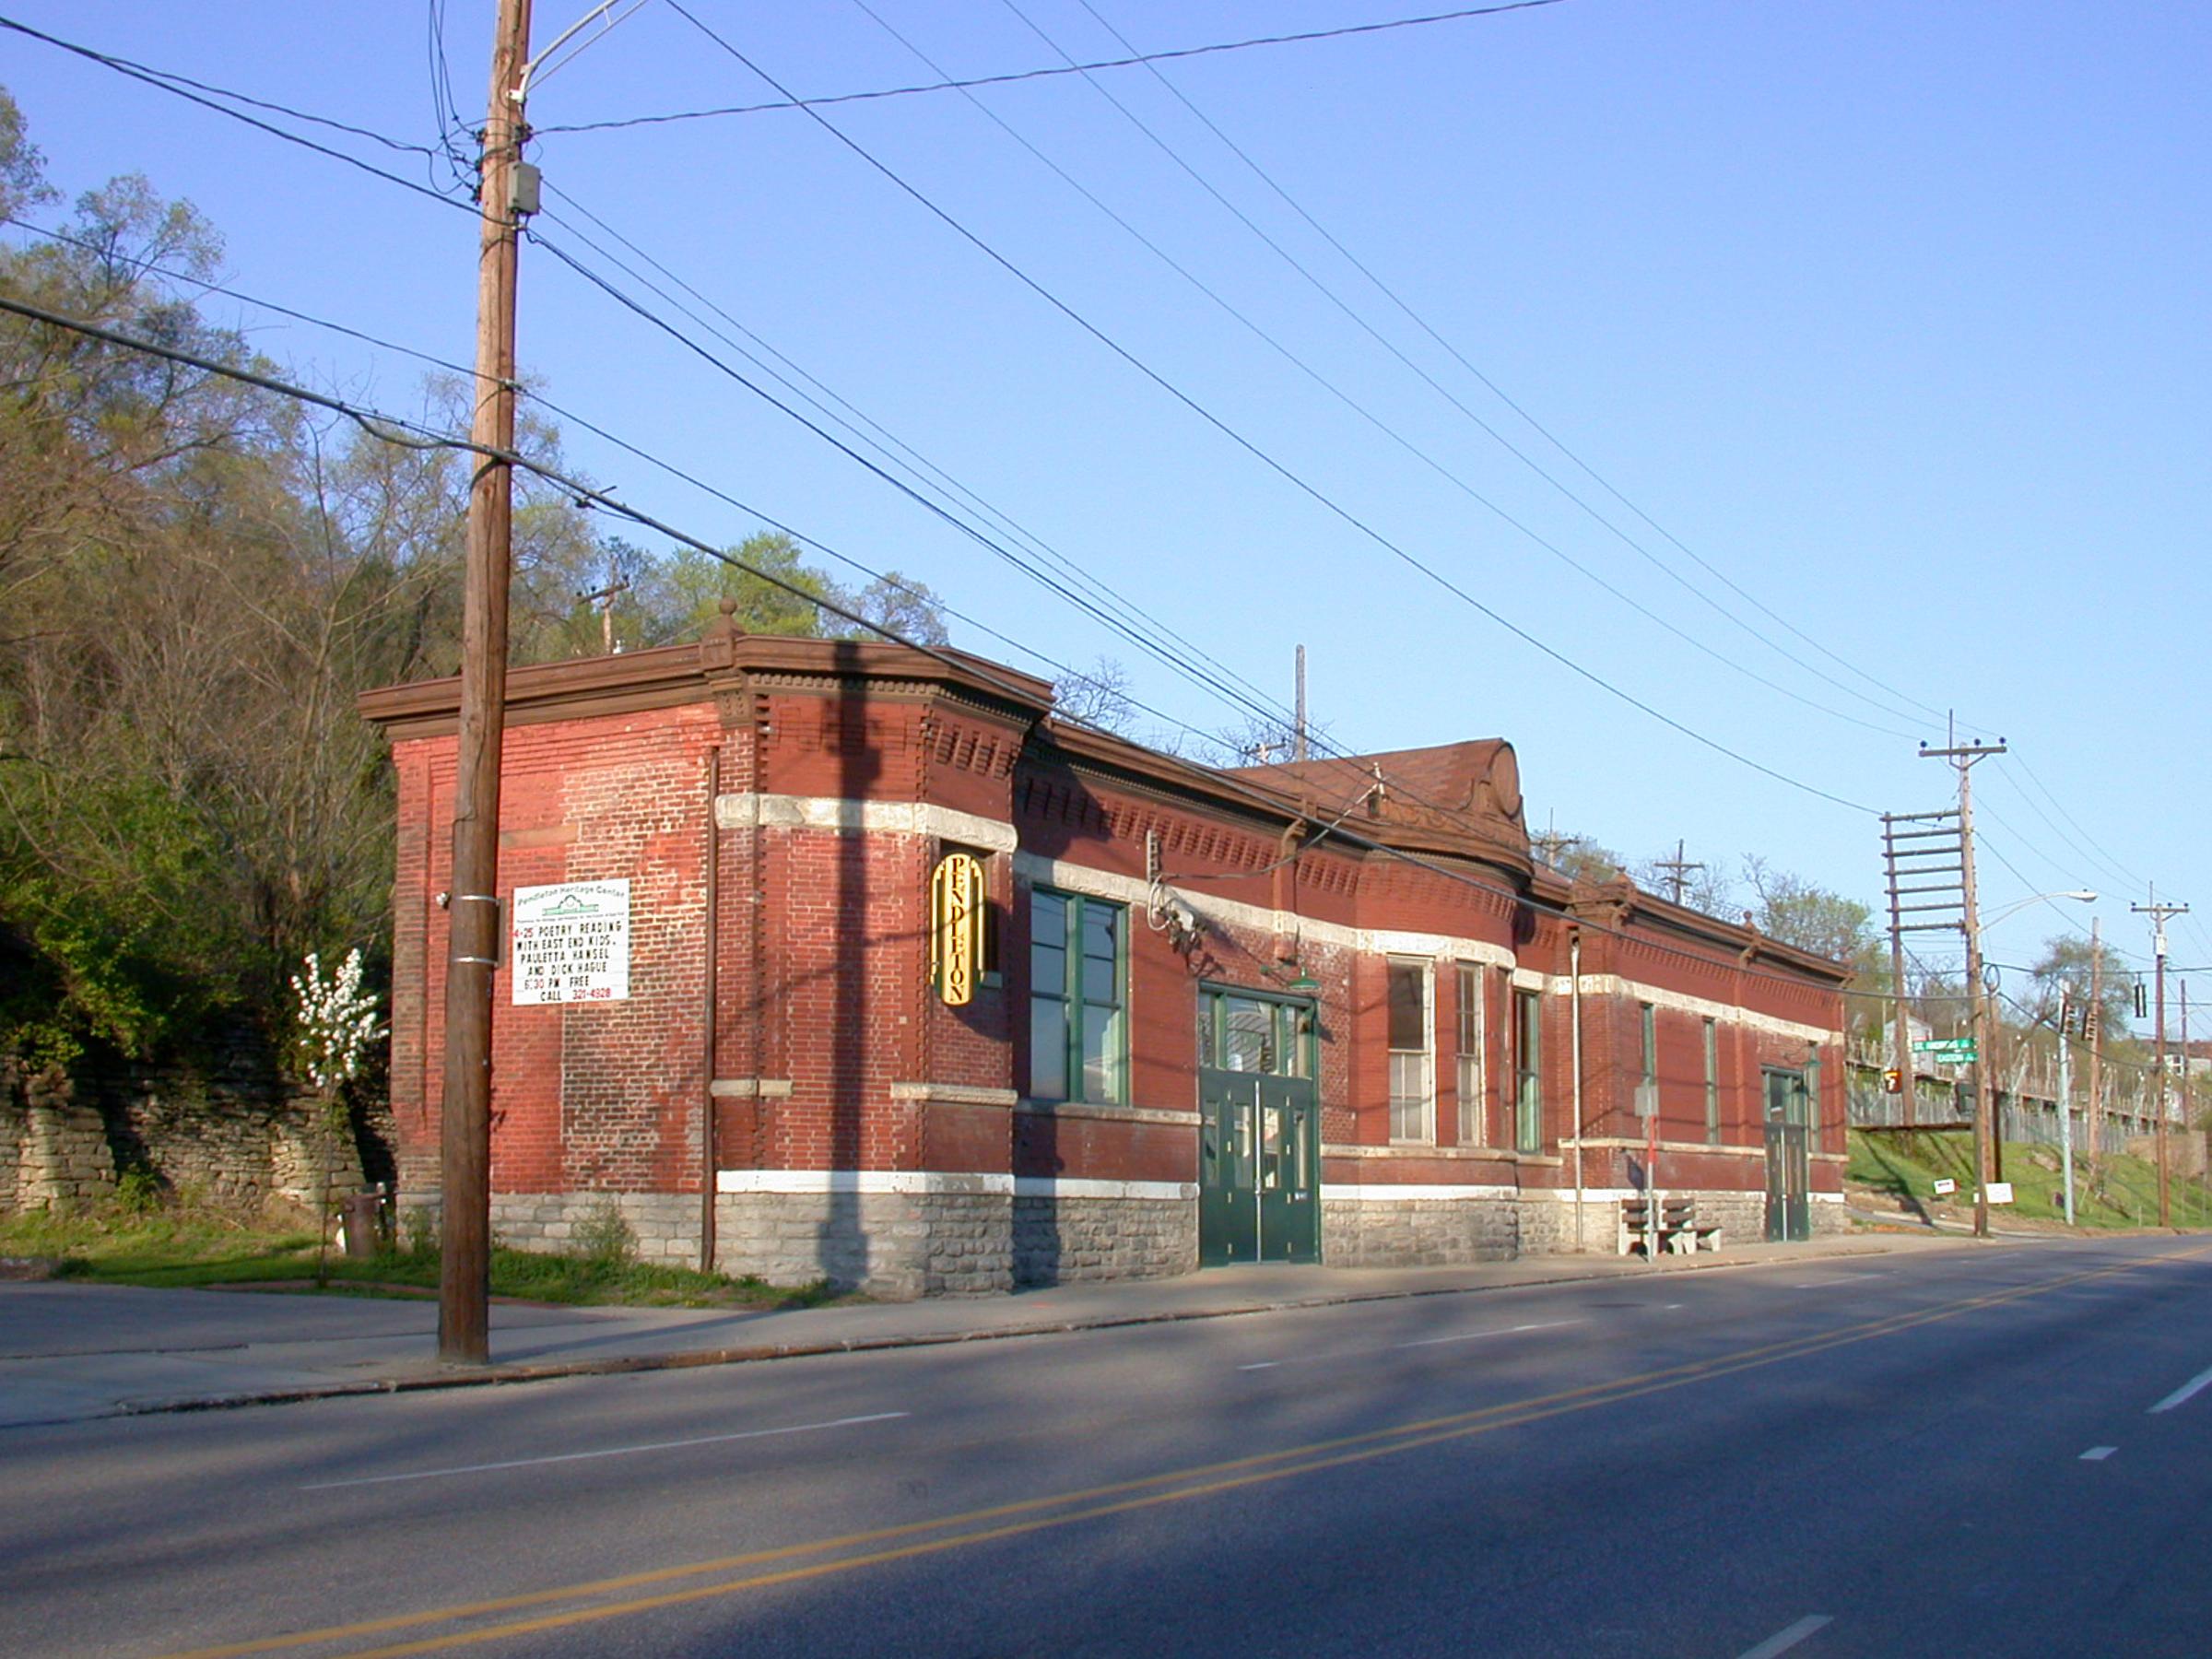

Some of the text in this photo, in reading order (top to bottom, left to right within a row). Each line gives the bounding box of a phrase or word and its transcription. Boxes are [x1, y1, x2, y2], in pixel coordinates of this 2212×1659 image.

[538, 924, 572, 937] POETRY
[580, 921, 622, 934] READING
[950, 857, 964, 1002] PENDLETON
[517, 940, 539, 951] WITH
[542, 938, 563, 949] EAST
[568, 937, 583, 948] END
[521, 948, 609, 963] PAULETTA HANSEL
[527, 961, 607, 976] AND DICK HAGUE
[548, 978, 560, 988] PM
[570, 975, 589, 987] FREE
[540, 991, 561, 1002] CALL
